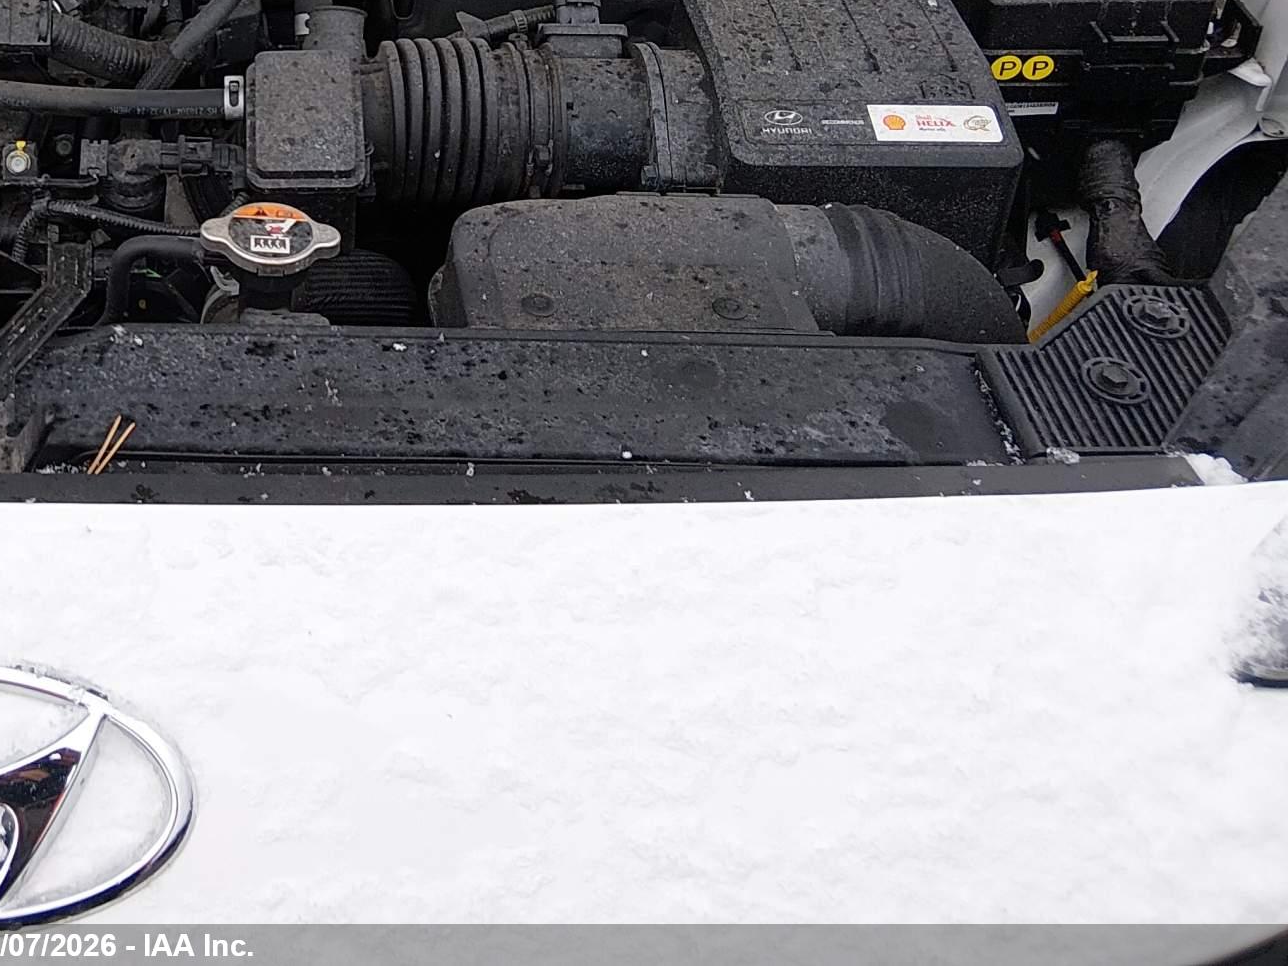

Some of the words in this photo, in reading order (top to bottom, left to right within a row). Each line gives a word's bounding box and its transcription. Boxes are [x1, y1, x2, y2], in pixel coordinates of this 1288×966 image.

[999, 60, 1017, 76] P
[1031, 60, 1049, 76] P
[916, 119, 957, 127] HELIX
[761, 127, 812, 135] HYUNDAI
